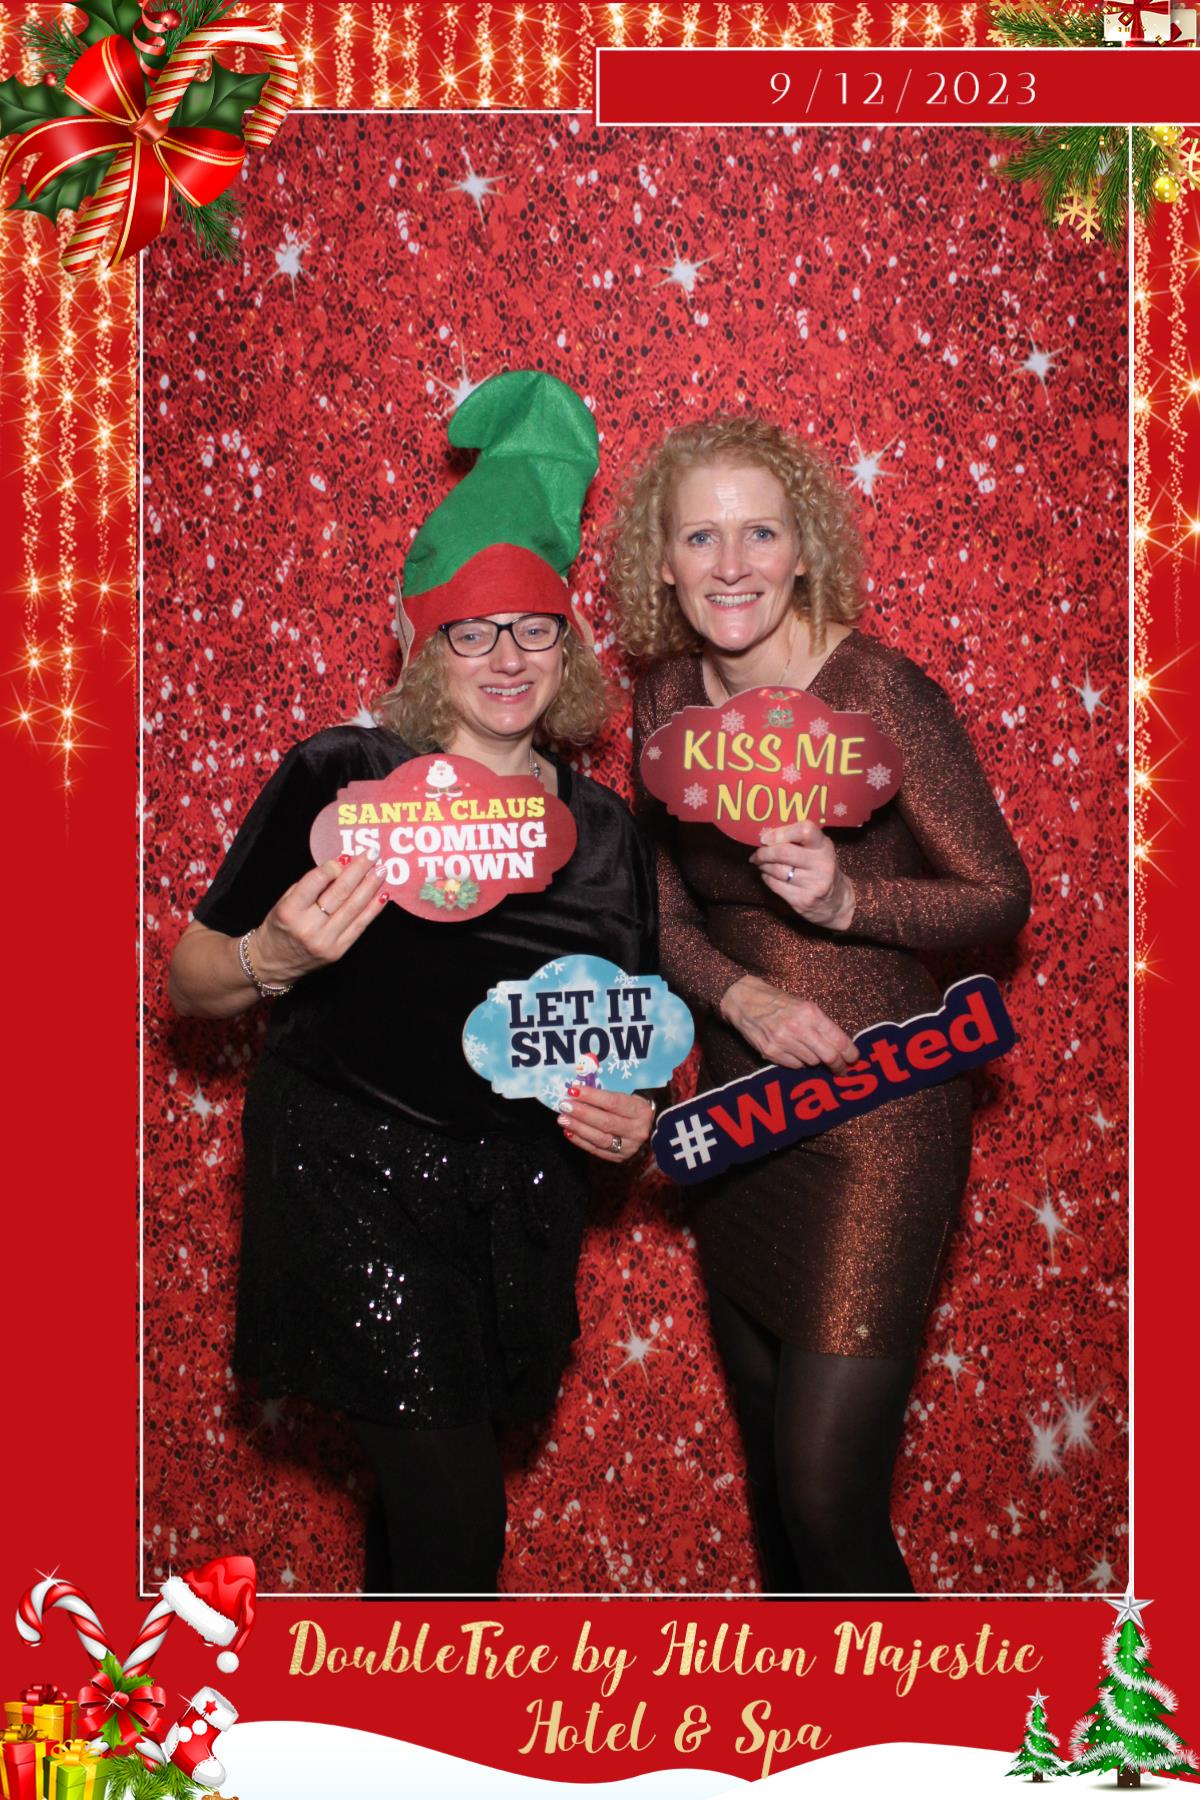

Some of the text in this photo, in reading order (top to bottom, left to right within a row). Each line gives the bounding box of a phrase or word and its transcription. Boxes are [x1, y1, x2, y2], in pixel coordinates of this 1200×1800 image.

[683, 730, 866, 776] KISS ME
[337, 796, 546, 825] SANTA CLAUS
[716, 779, 829, 824] NOW!
[340, 821, 547, 856] IS COMING
[376, 851, 535, 886] O TOWN
[508, 987, 652, 1029] LET IT
[511, 1024, 654, 1068] SNOW
[668, 990, 999, 1171] #Wasted
